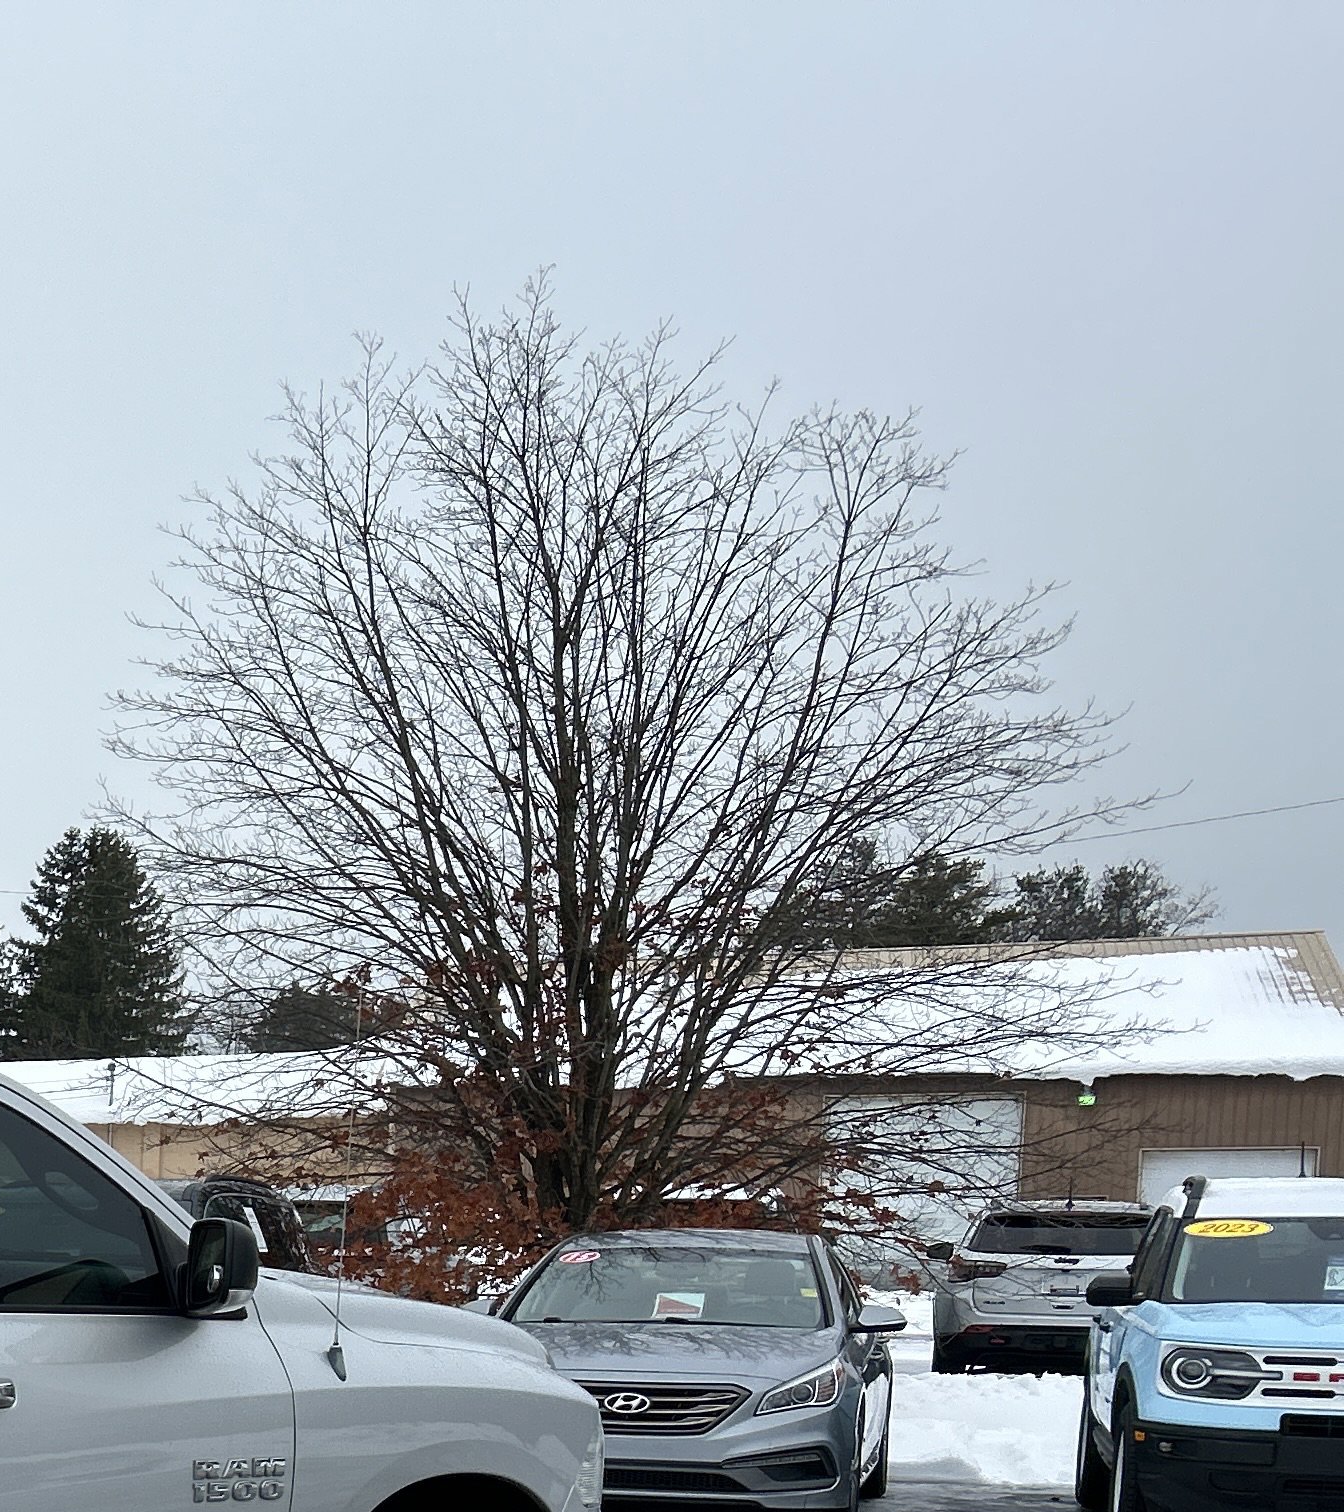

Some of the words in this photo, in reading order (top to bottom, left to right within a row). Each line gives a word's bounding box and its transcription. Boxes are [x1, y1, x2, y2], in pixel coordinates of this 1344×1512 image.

[1198, 1223, 1260, 1234] 2023
[193, 1457, 286, 1480] RAM
[193, 1480, 285, 1503] 1500
